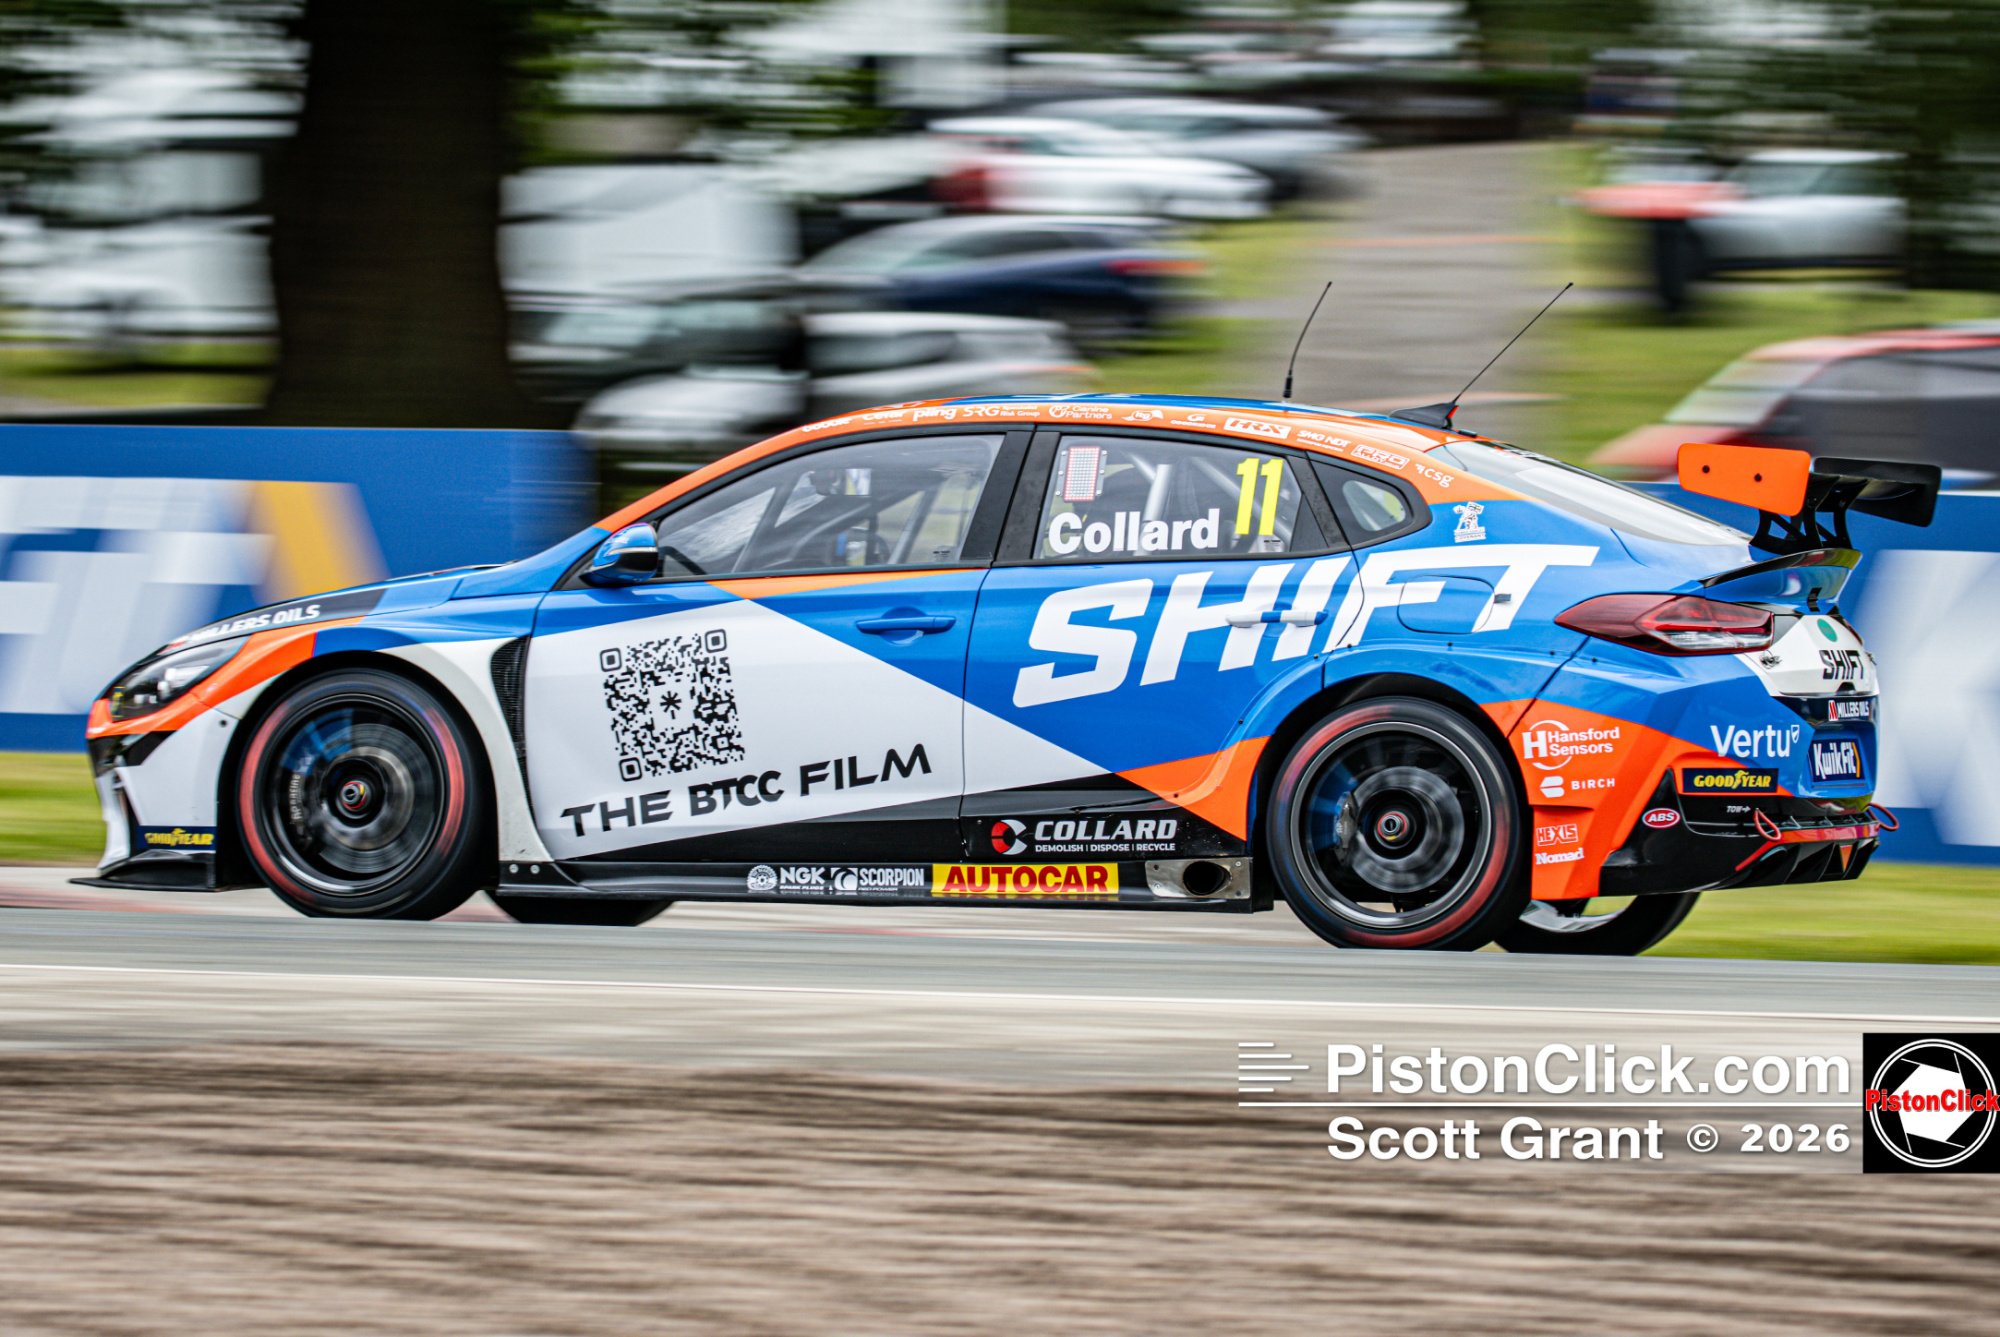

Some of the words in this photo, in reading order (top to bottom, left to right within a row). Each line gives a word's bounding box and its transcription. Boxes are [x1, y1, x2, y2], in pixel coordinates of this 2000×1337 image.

[963, 406, 999, 417] SRG
[1065, 411, 1112, 419] Partners
[1229, 419, 1285, 435] HRX
[1324, 436, 1351, 448] NDT
[1235, 458, 1284, 536] 11
[1047, 508, 1220, 554] Collard
[272, 604, 321, 624] OILS
[1012, 544, 1601, 708] SHIFT
[1819, 649, 1864, 680] SHIFT
[1836, 701, 1859, 718] MILLERS
[1548, 727, 1621, 743] Hansford
[1710, 724, 1791, 758] Vertu
[1549, 742, 1614, 757] Sensors
[1813, 741, 1857, 780] KwikFit
[1571, 778, 1616, 790] BIRCH
[1693, 769, 1772, 789] GOODYEAR
[560, 789, 673, 837] THE
[688, 770, 785, 817] BTCC
[799, 743, 933, 797] FILM
[1647, 812, 1676, 823] ABS
[1726, 805, 1743, 813] TOW
[1034, 819, 1178, 841] COLLARD
[1536, 824, 1578, 844] HEXIS
[1035, 844, 1084, 852] DEMOLISH
[1090, 843, 1130, 852] DISPOSE
[1136, 843, 1176, 851] RECYCLE
[1535, 848, 1585, 865] Nomad
[780, 866, 826, 885] NGK
[859, 867, 925, 886] SCORPION
[941, 865, 1109, 893] AUTOCAR
